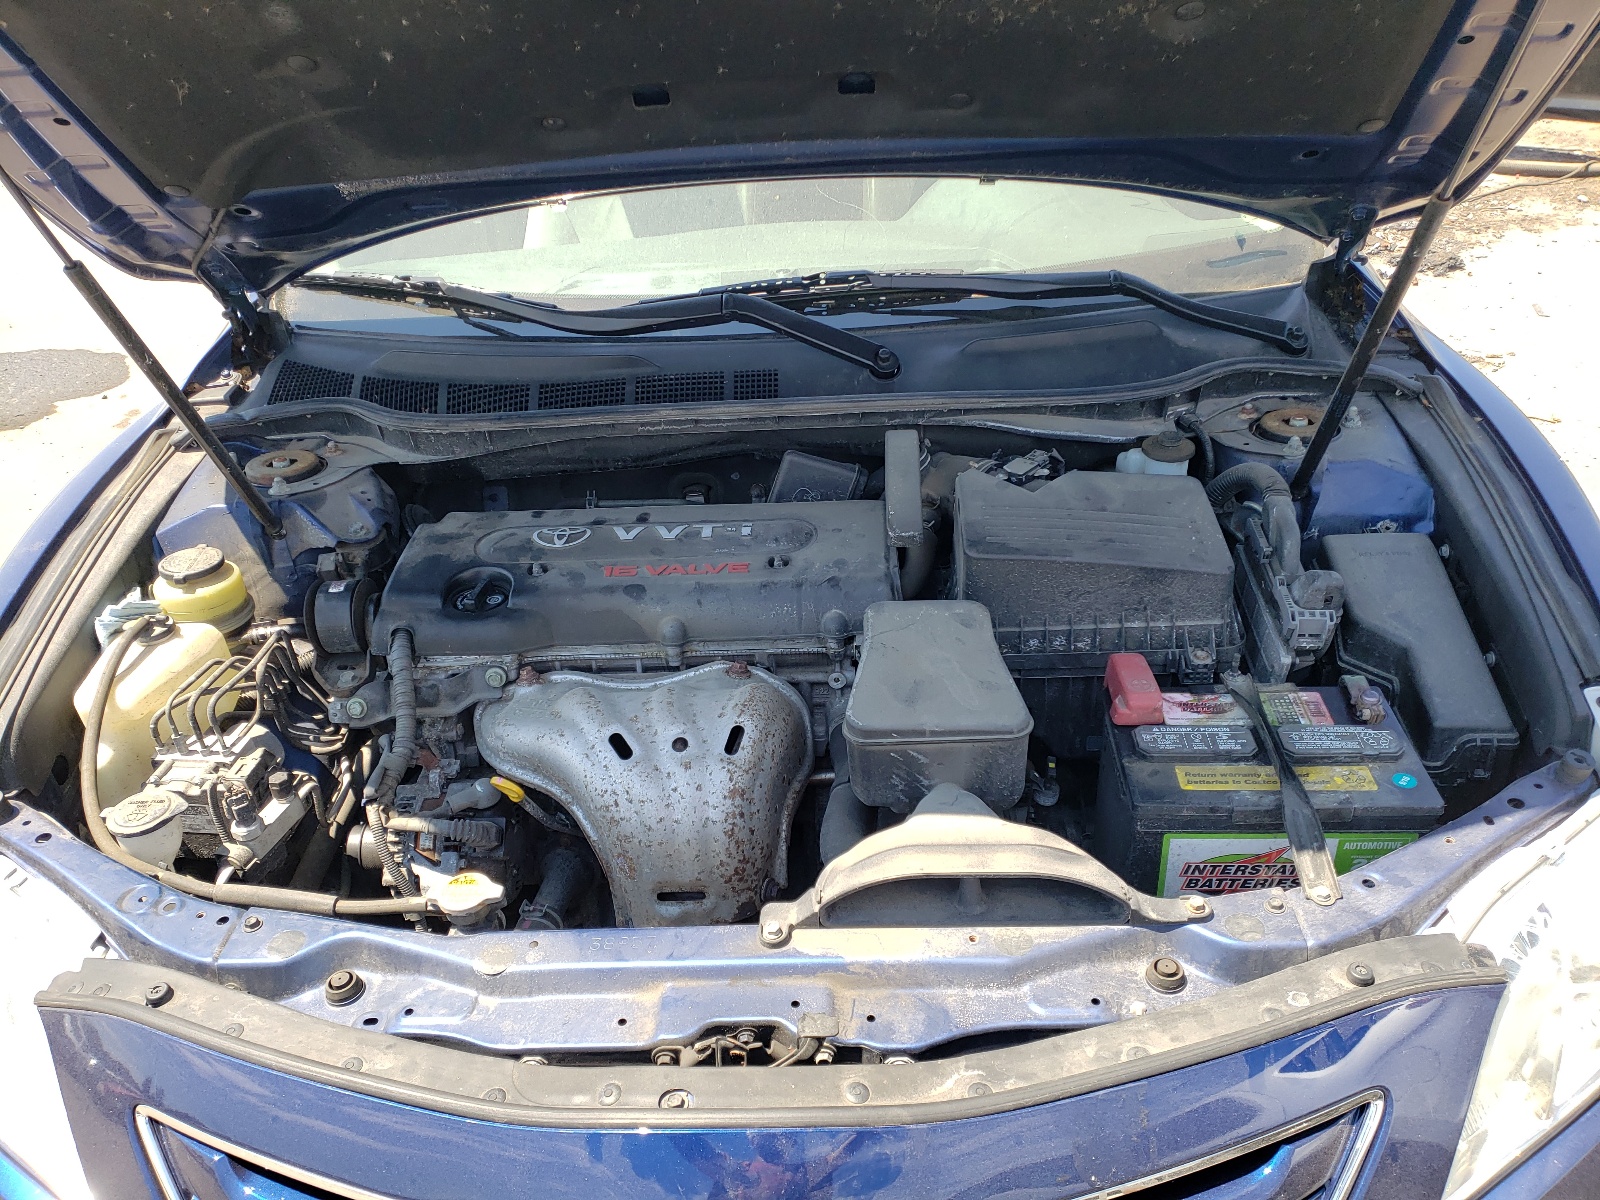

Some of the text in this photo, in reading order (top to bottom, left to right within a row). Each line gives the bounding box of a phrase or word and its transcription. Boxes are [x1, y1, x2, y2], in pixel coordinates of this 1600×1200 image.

[603, 562, 750, 577] 16 VALVE
[1343, 841, 1403, 850] AUTOMOTIVE
[1183, 864, 1298, 876] INTERSTAT
[1185, 877, 1301, 889] BATTERIES
